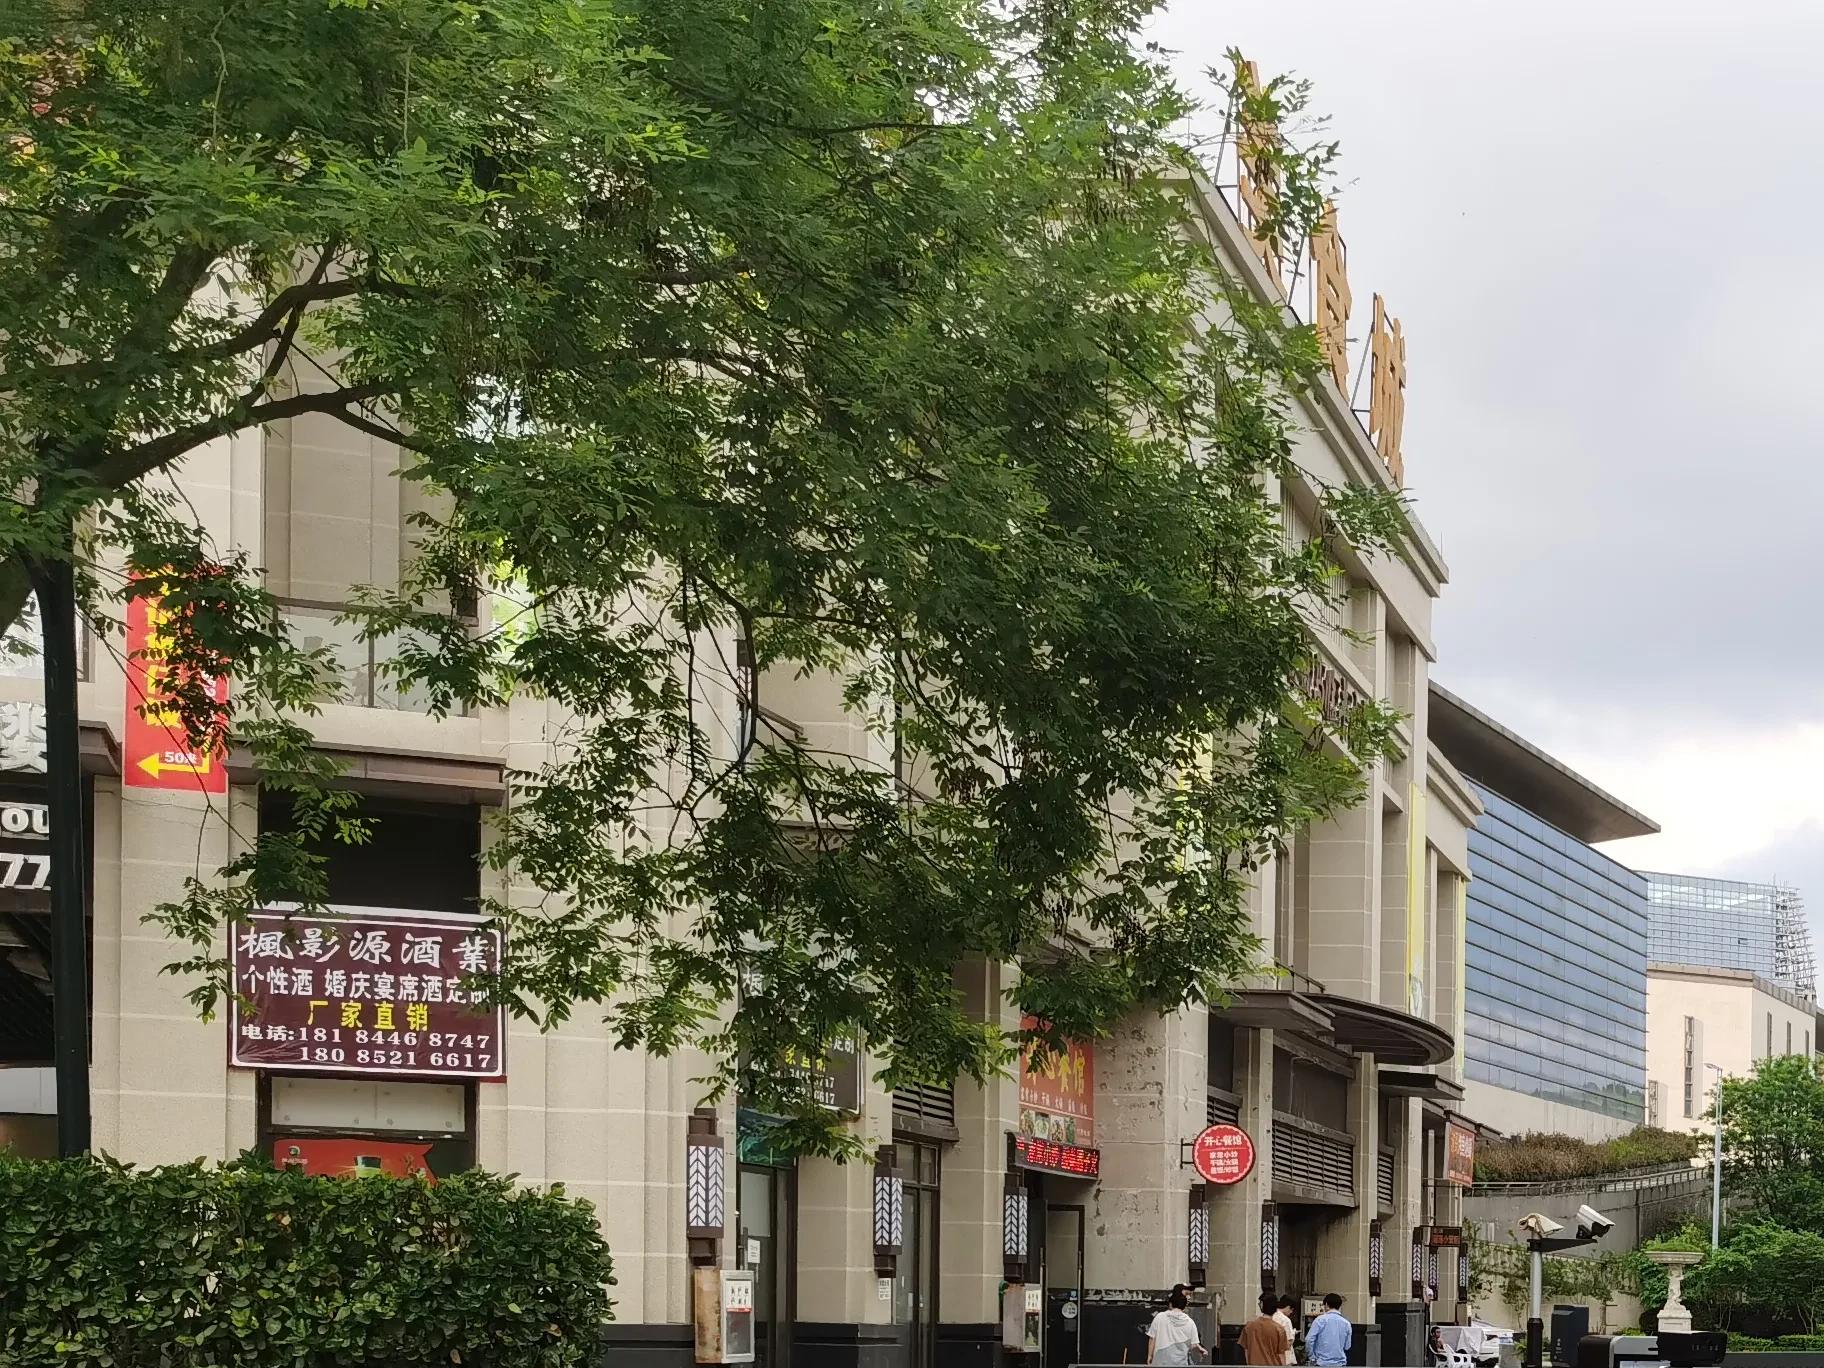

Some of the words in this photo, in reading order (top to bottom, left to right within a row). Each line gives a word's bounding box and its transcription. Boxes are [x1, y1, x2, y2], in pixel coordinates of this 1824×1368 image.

[241, 965, 313, 996] 个性酒
[307, 1000, 429, 1031] 厂家直销
[355, 1029, 417, 1046] 8446
[428, 1033, 490, 1048] 8747
[300, 1047, 345, 1062] 180
[356, 1050, 417, 1065] 8521
[430, 1053, 491, 1067] 6617
